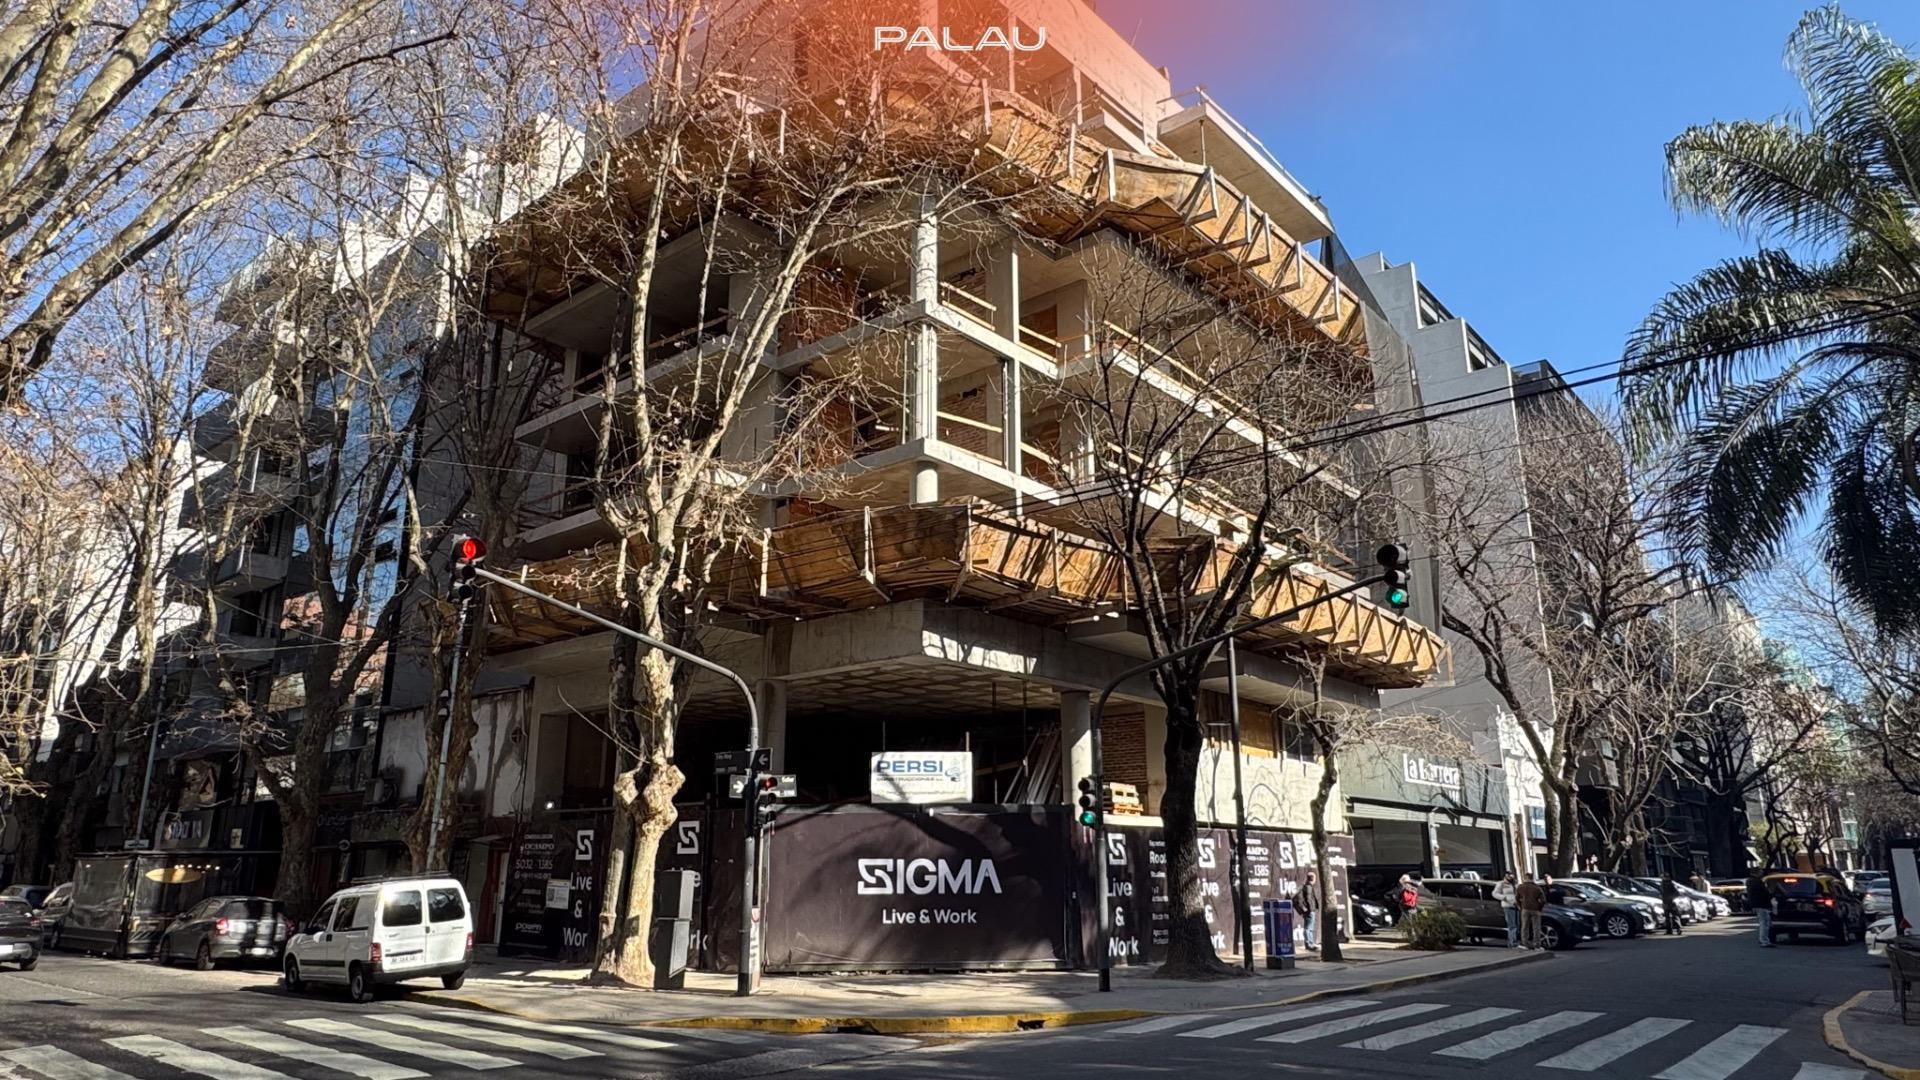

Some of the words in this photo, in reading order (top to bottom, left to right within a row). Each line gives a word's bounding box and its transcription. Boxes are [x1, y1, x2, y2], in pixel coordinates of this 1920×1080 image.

[877, 761, 943, 773] PERSI
[570, 872, 592, 891] Live
[857, 858, 1003, 895] SIGMA
[574, 900, 583, 918] &
[882, 909, 916, 924] Live
[919, 909, 931, 924] &
[934, 909, 977, 924] Work
[1115, 906, 1126, 927] &
[563, 927, 588, 948] Wor
